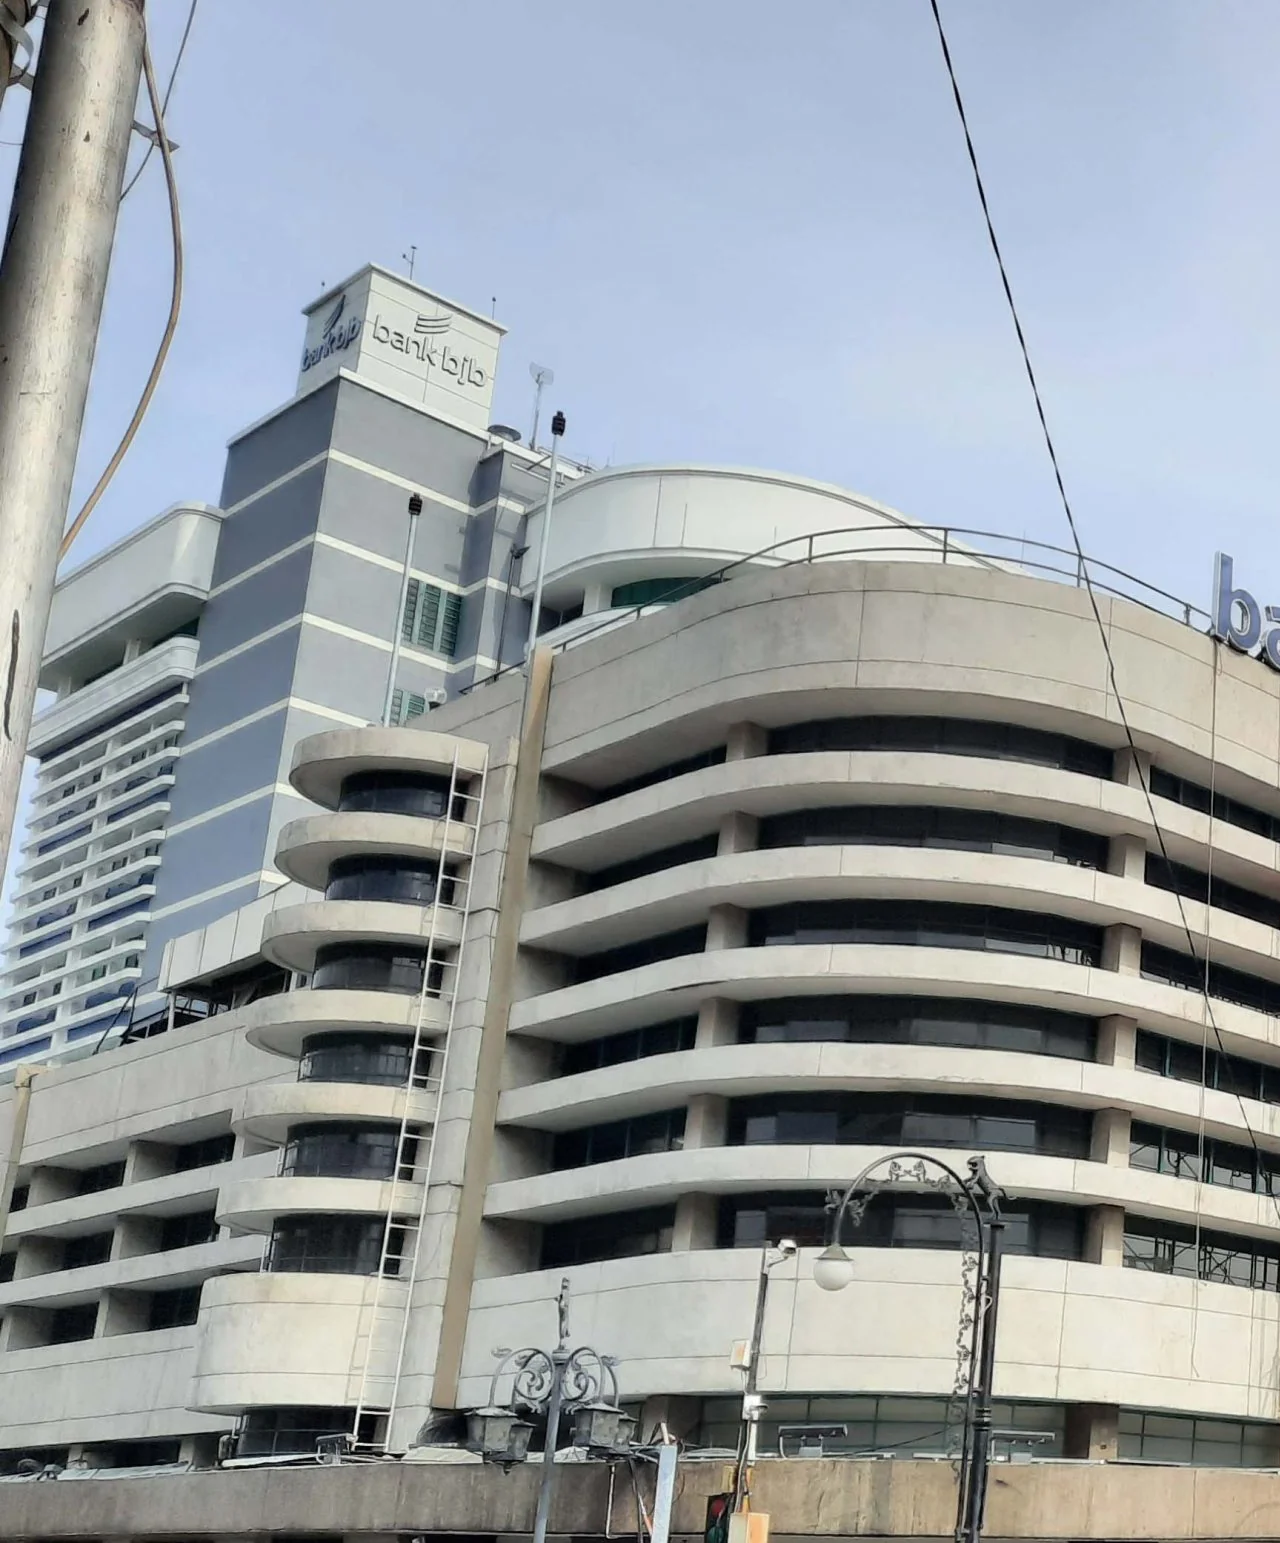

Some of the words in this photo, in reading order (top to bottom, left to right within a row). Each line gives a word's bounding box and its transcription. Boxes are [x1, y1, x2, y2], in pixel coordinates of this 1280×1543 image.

[301, 332, 336, 373] bank
[334, 316, 362, 350] bjb
[373, 314, 437, 367] bank
[442, 346, 489, 388] bjb
